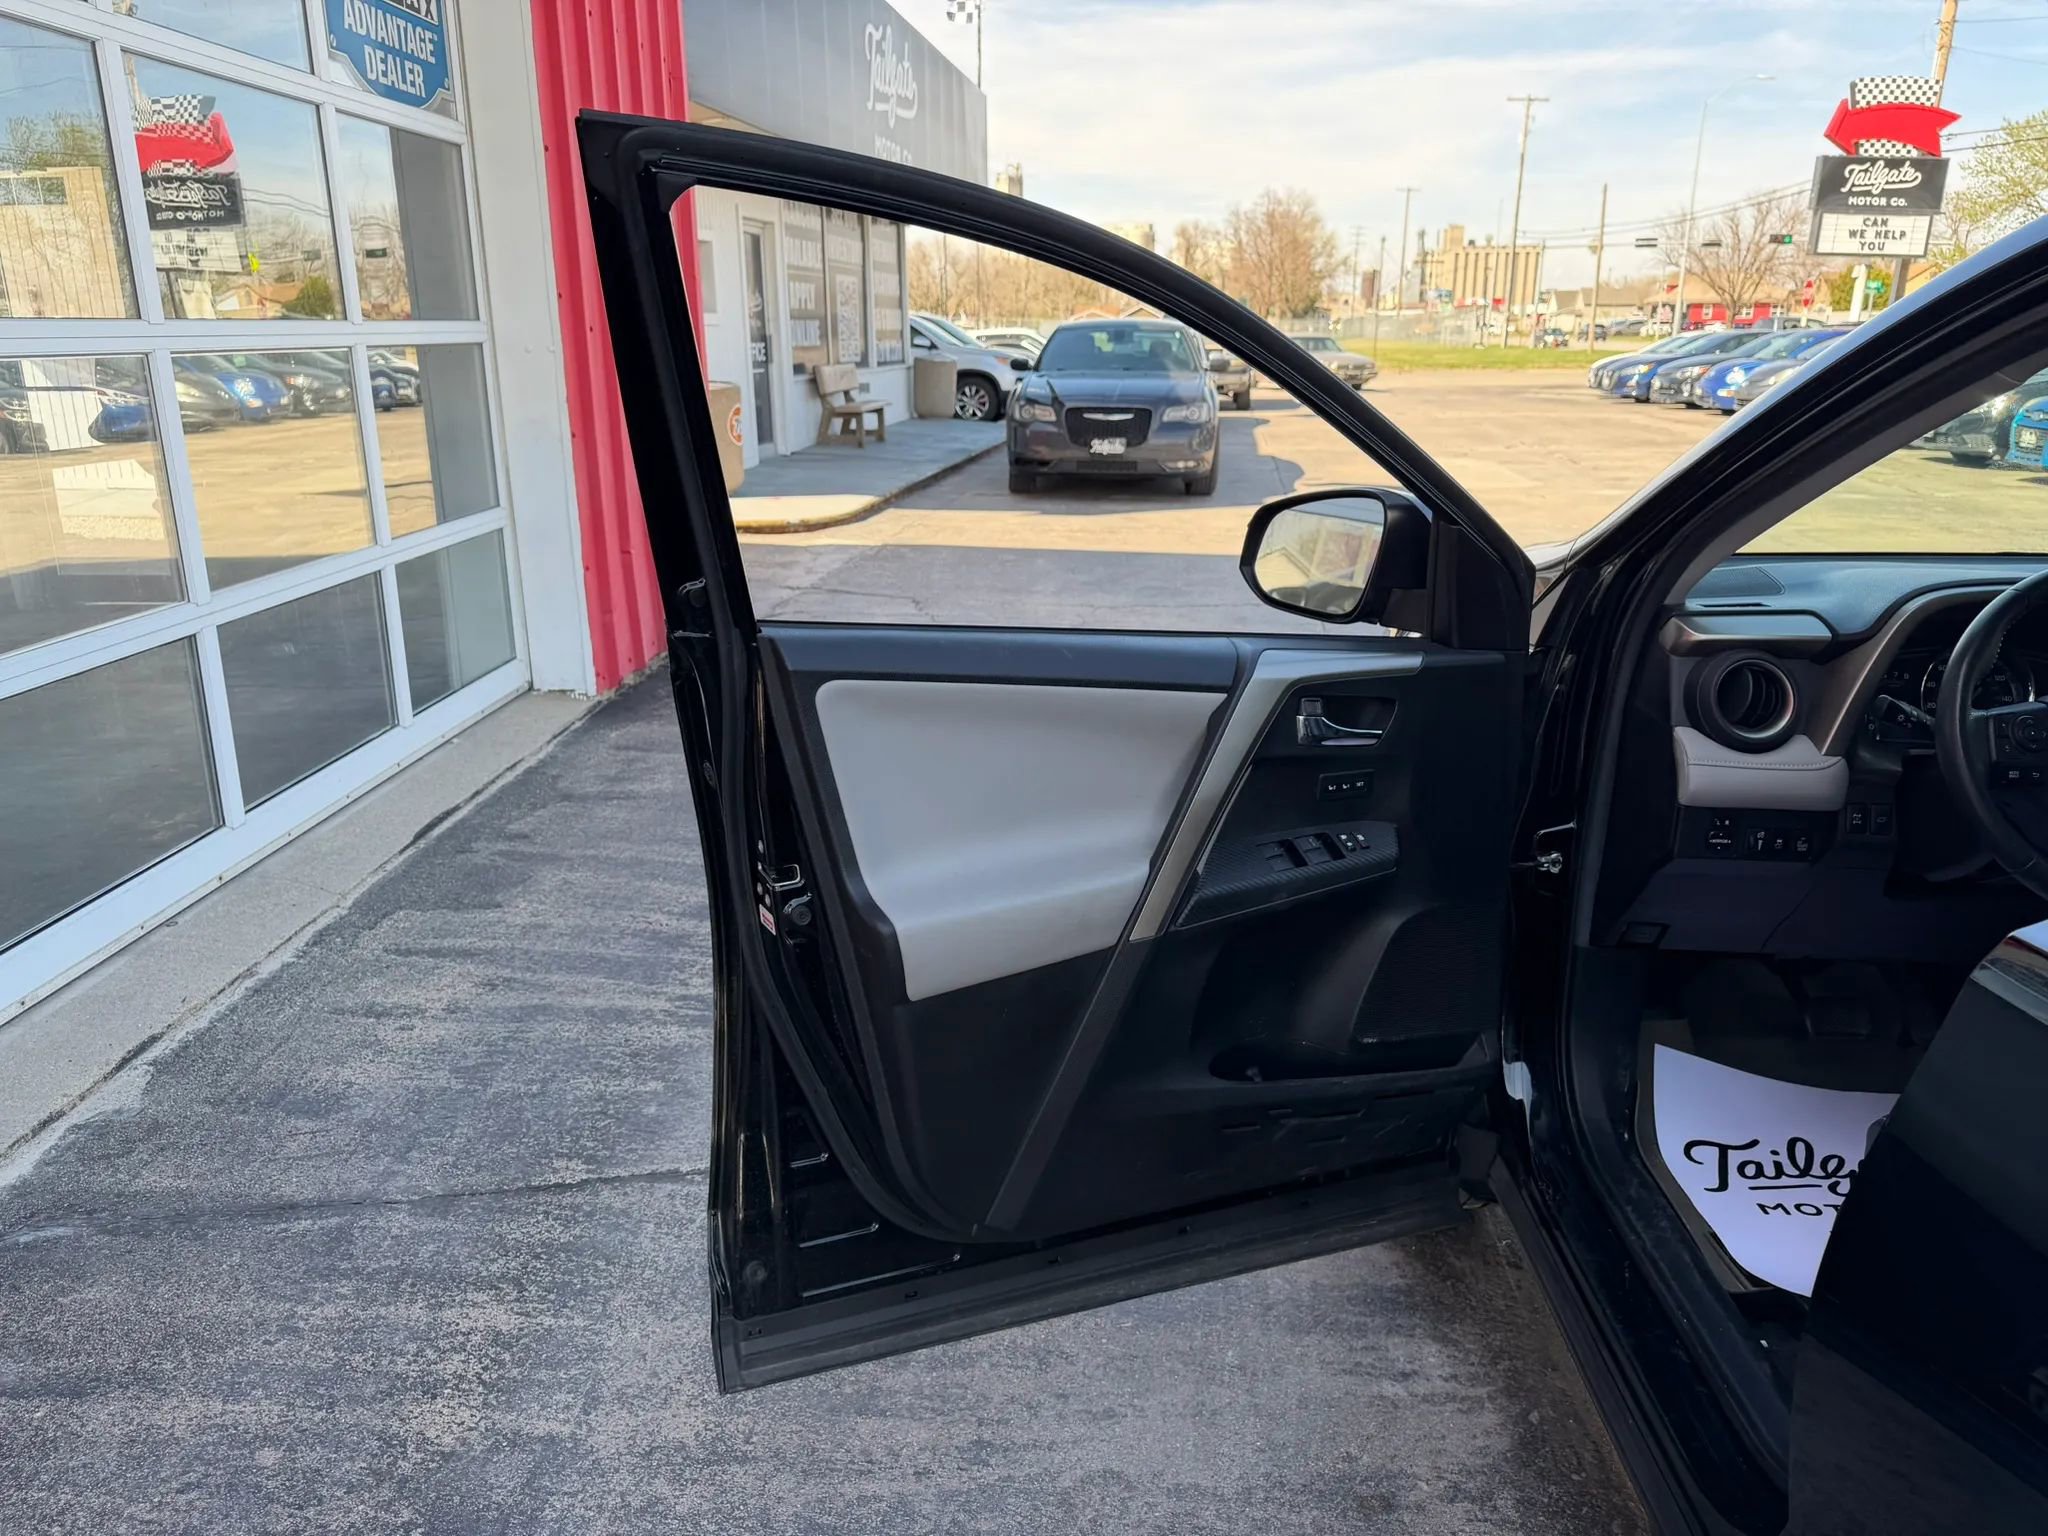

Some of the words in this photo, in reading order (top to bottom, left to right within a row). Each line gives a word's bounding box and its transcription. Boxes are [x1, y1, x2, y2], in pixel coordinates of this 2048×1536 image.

[343, 0, 436, 64] ADVANTAGE
[364, 44, 426, 98] DEALER
[1840, 159, 1922, 195] Tailgate
[1848, 196, 1887, 206] MOTOR
[1890, 197, 1908, 206] CO.
[1862, 217, 1889, 228] CAN
[1848, 229, 1867, 239] WE
[1874, 229, 1907, 240] HELP
[1859, 241, 1886, 251] YOU
[1683, 1136, 1863, 1197] Tailg
